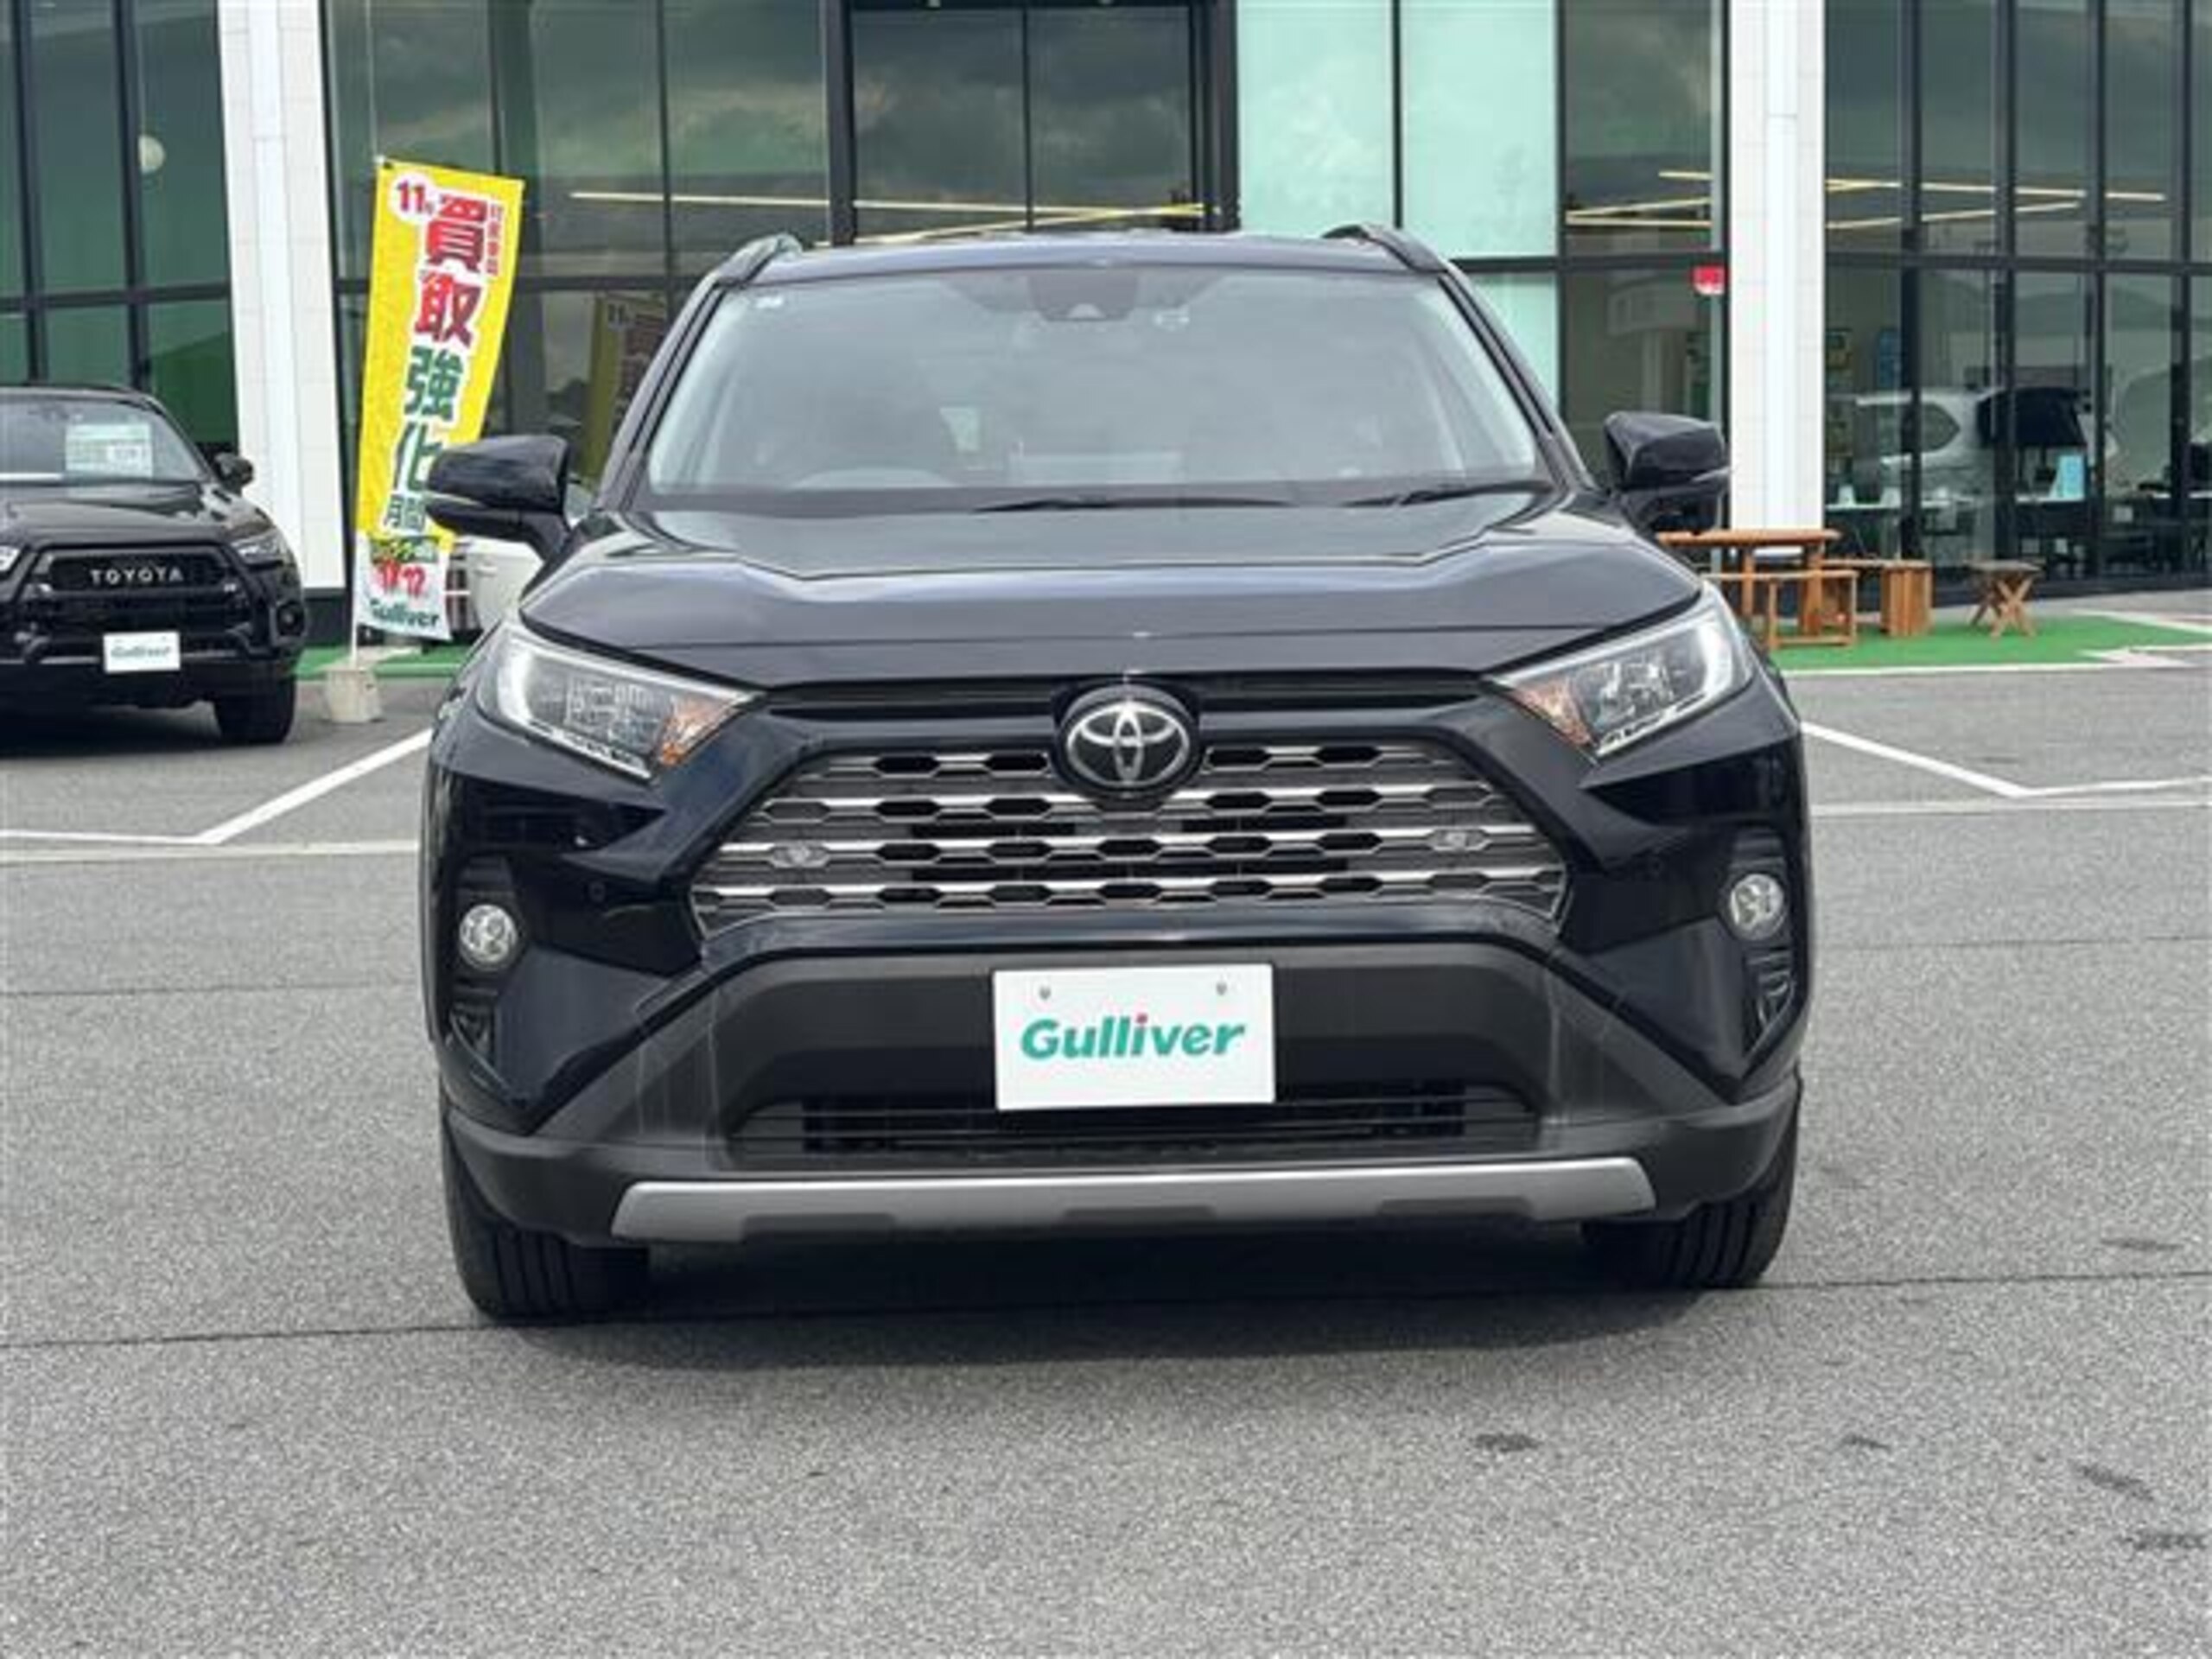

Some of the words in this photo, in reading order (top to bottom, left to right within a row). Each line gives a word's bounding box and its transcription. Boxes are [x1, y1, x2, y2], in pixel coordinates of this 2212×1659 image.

[393, 193, 487, 491] 買取強化
[90, 566, 183, 585] TOYOTA
[1020, 1013, 1246, 1060] Gulliver
